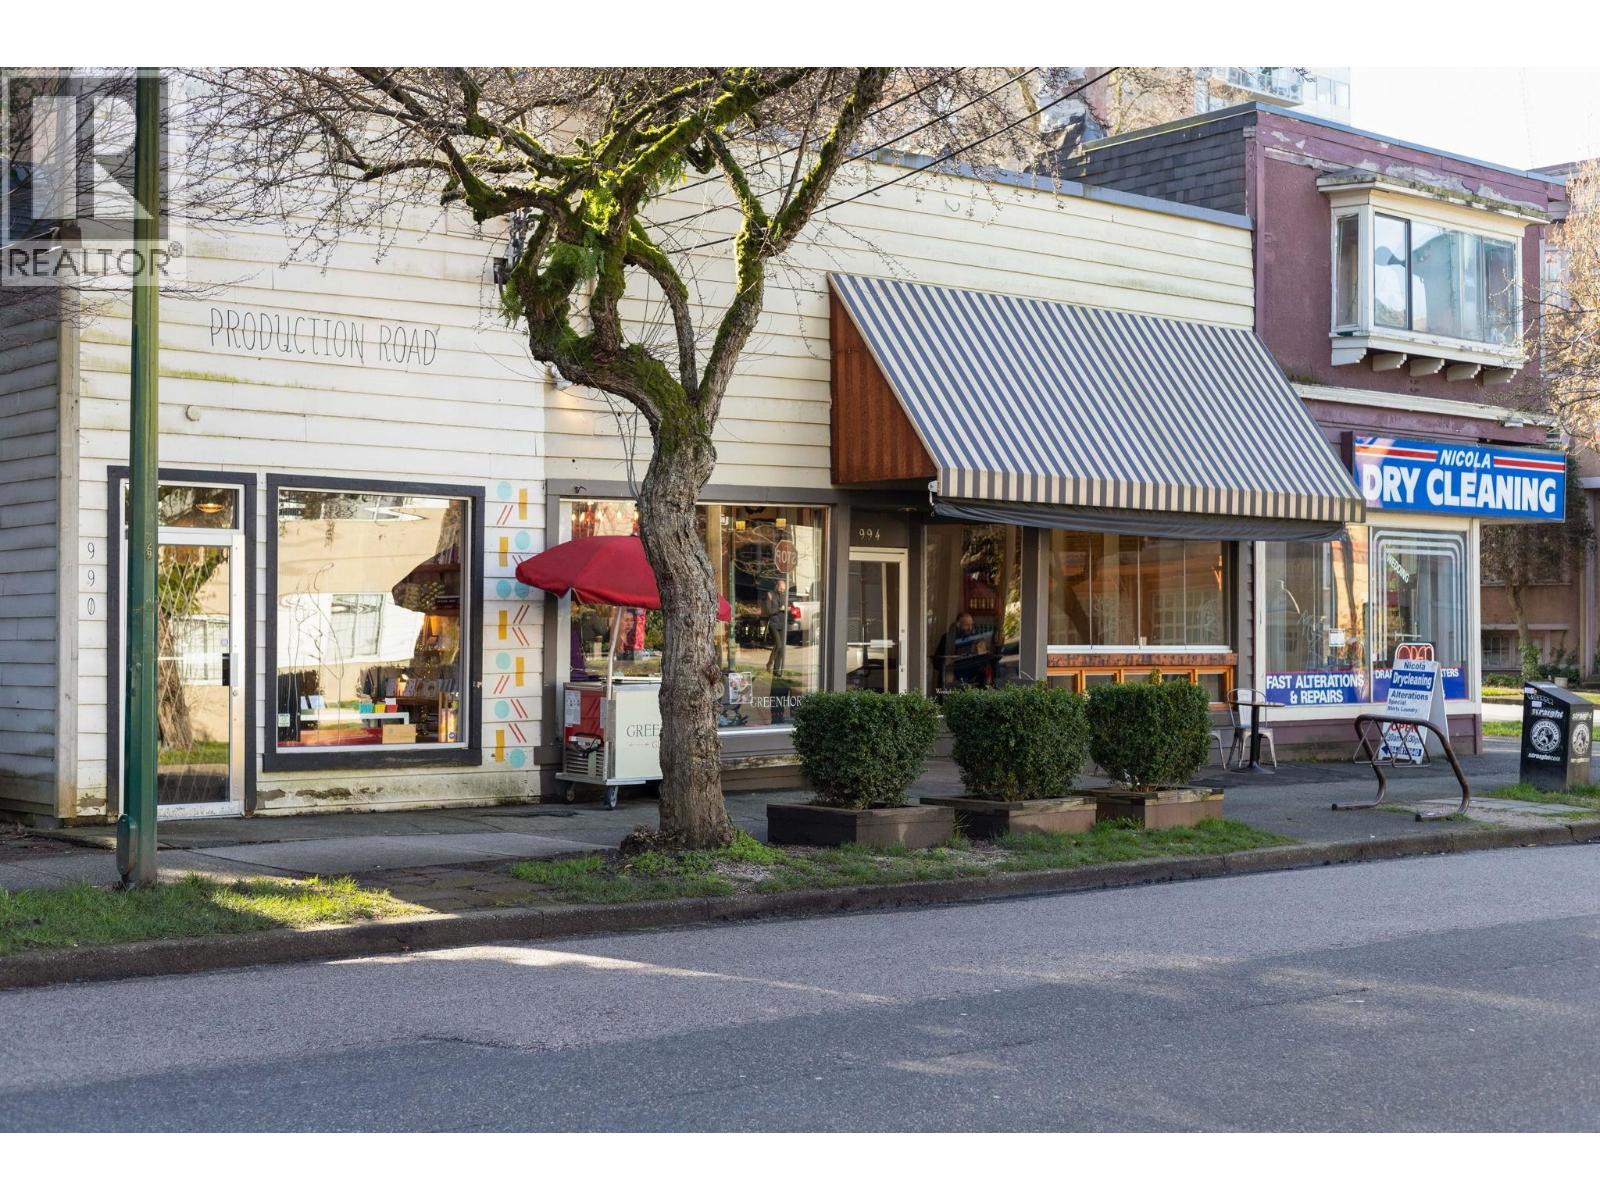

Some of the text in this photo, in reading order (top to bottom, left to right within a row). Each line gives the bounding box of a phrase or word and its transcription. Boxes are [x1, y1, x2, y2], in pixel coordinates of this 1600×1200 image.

[210, 308, 438, 366] PRODUCTION ROAD
[1439, 449, 1491, 469] NICOLA
[1362, 464, 1557, 513] DRY CLEANING
[859, 528, 880, 541] 994
[1404, 661, 1426, 670] Nicola
[1266, 674, 1365, 690] FAST ALTERATIONS
[1392, 671, 1433, 689] Drycleaning
[751, 696, 803, 708] GREENHOR
[1290, 690, 1344, 704] & REPAIRS
[1391, 690, 1429, 701] Alterations
